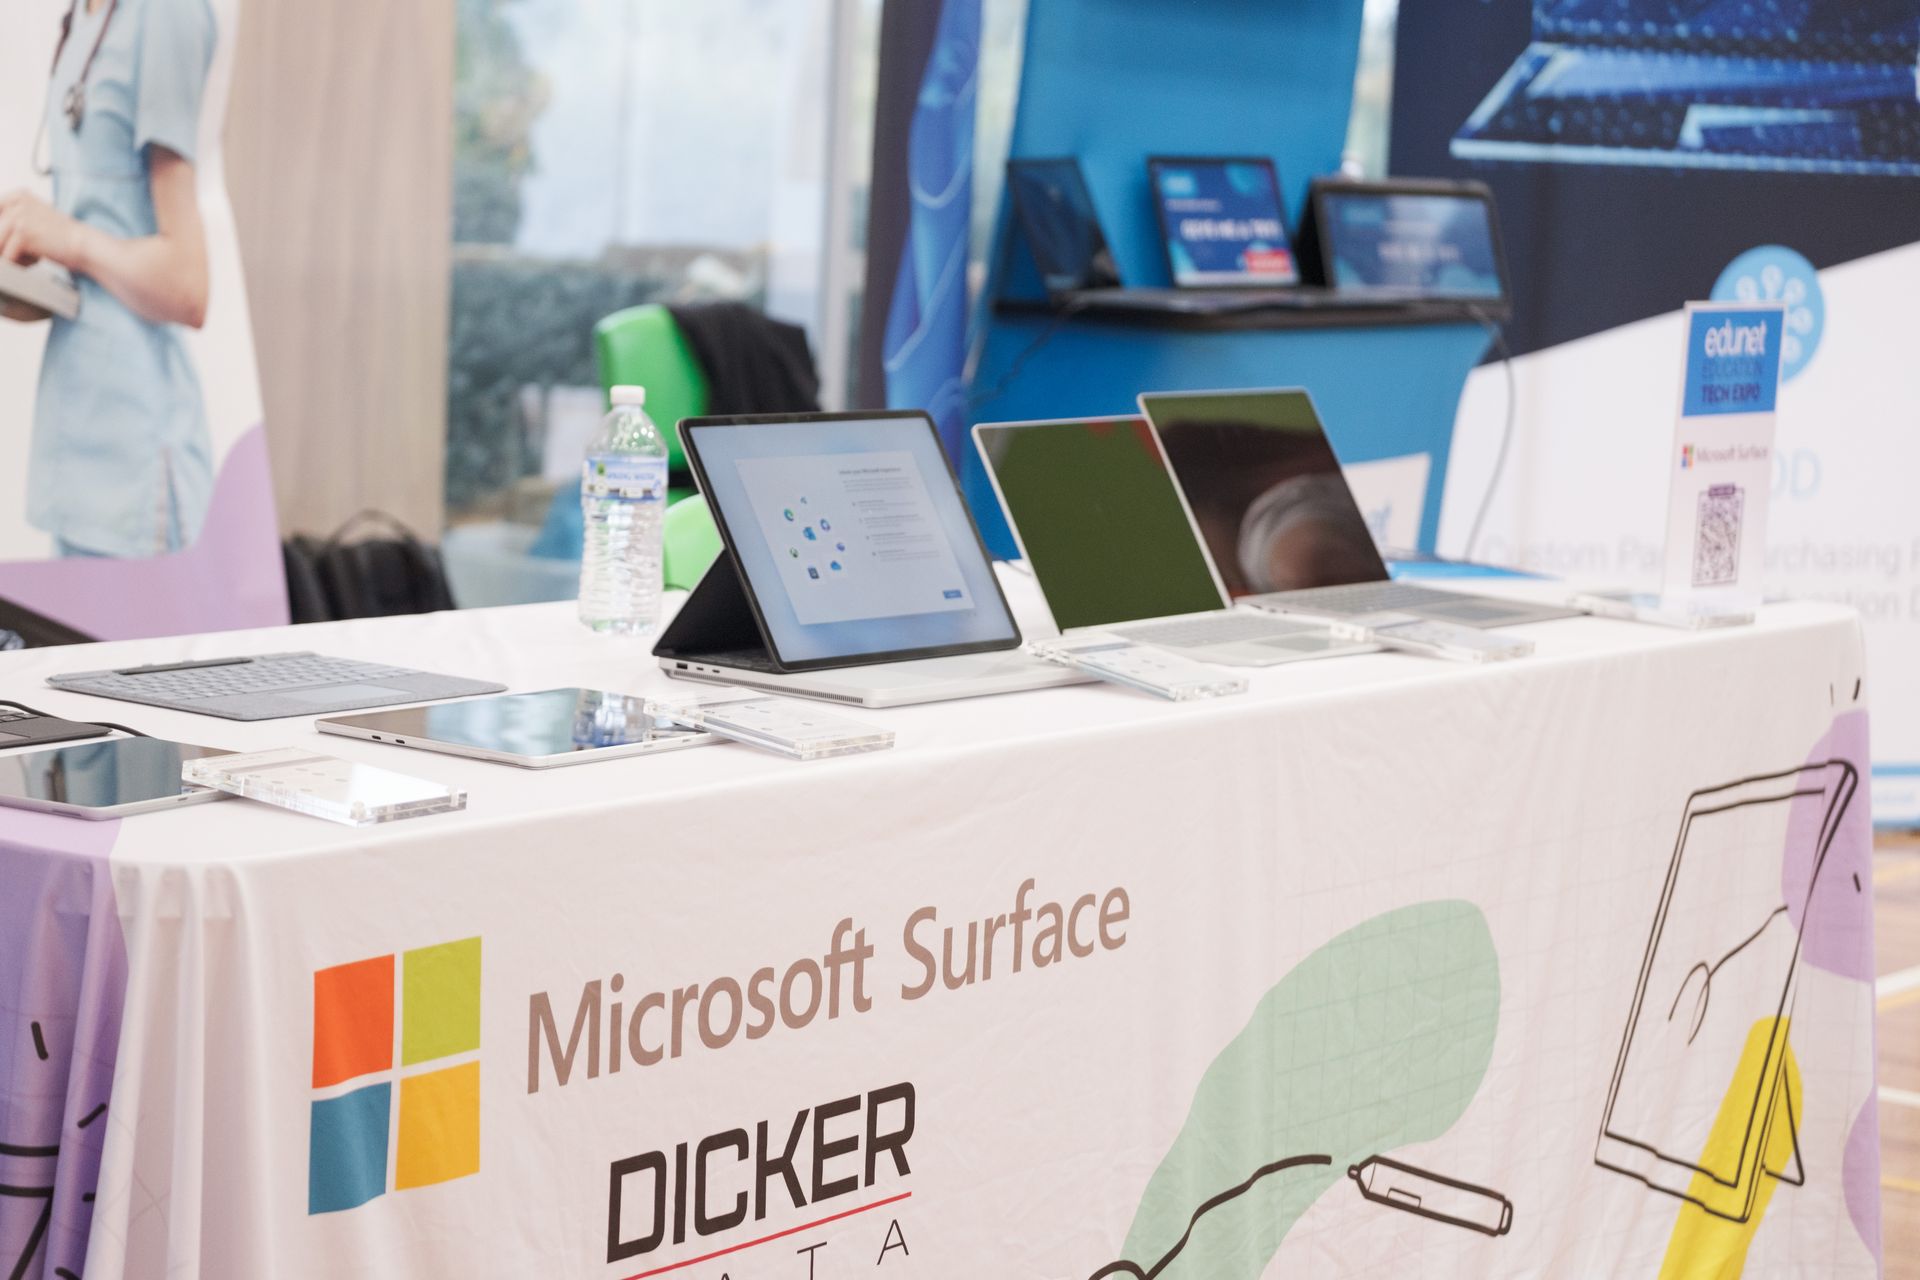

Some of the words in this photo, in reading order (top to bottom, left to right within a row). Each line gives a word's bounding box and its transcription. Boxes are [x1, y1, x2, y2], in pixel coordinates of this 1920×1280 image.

[1702, 384, 1729, 403] TECH
[1733, 381, 1760, 402] EXPO
[1704, 318, 1767, 357] edunet
[527, 917, 874, 1095] Microsoft
[901, 877, 1130, 1000] Surface
[607, 1081, 916, 1264] DICKER
